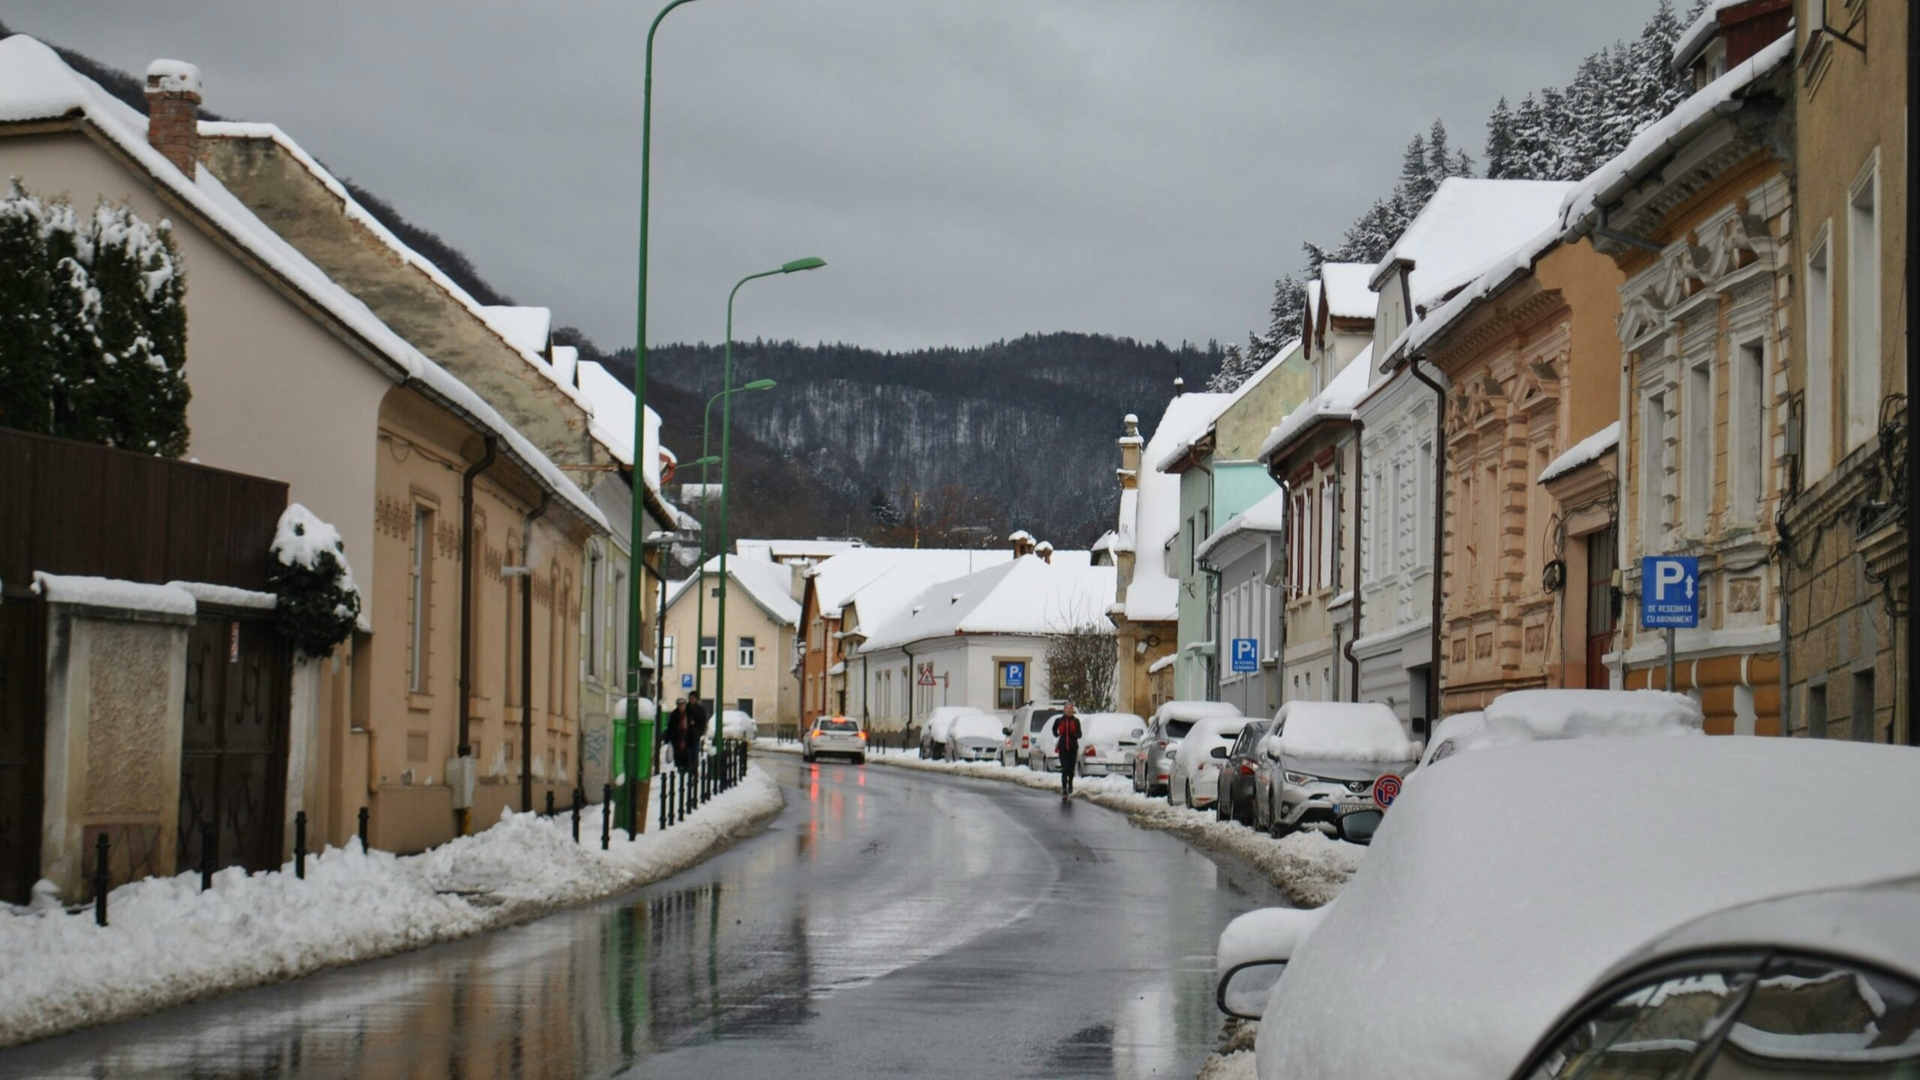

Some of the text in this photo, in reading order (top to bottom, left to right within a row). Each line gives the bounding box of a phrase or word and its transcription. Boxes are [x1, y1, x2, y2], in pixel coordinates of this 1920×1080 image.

[1656, 561, 1685, 600] P
[1646, 615, 1693, 623] CU ABONAMENT
[1237, 640, 1251, 659] P
[1009, 665, 1019, 679] P
[683, 675, 691, 684] P
